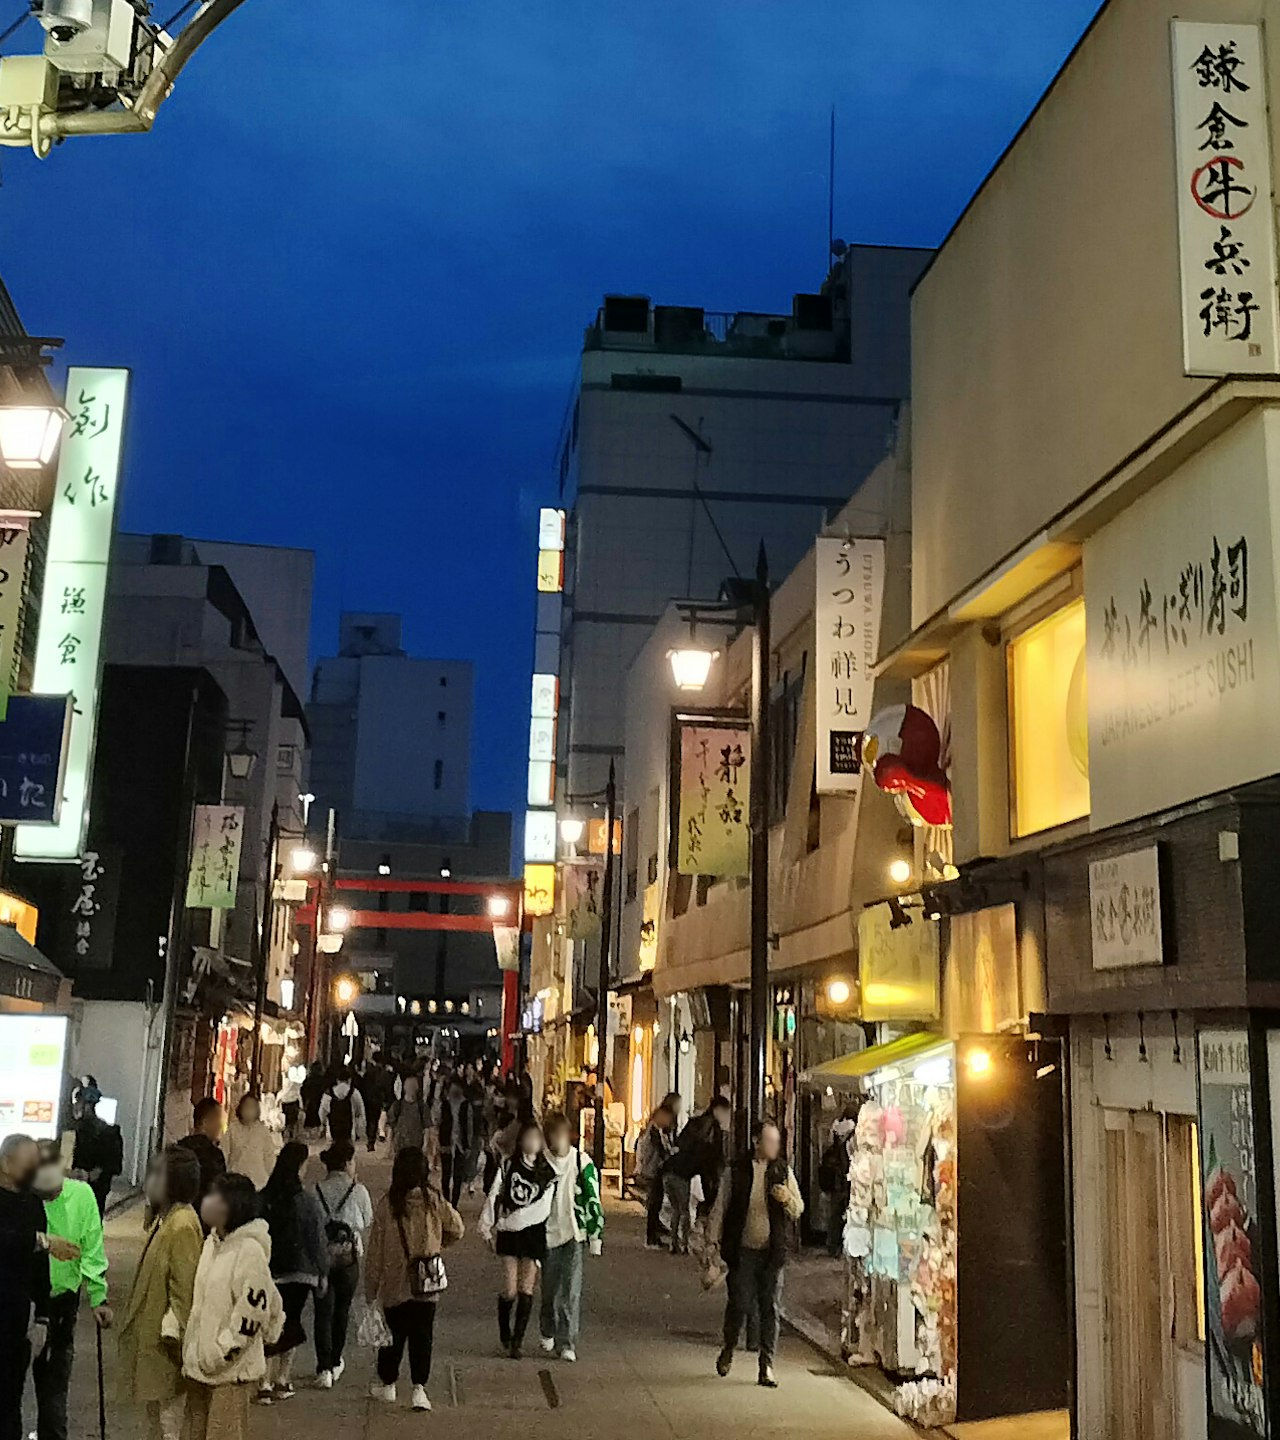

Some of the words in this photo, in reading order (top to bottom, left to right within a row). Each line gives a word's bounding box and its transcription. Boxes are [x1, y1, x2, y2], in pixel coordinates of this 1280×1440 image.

[1190, 40, 1260, 341] 鎌倉牛兵衛
[830, 553, 858, 715] うつわ祥見
[1206, 638, 1256, 698] SUSHI
